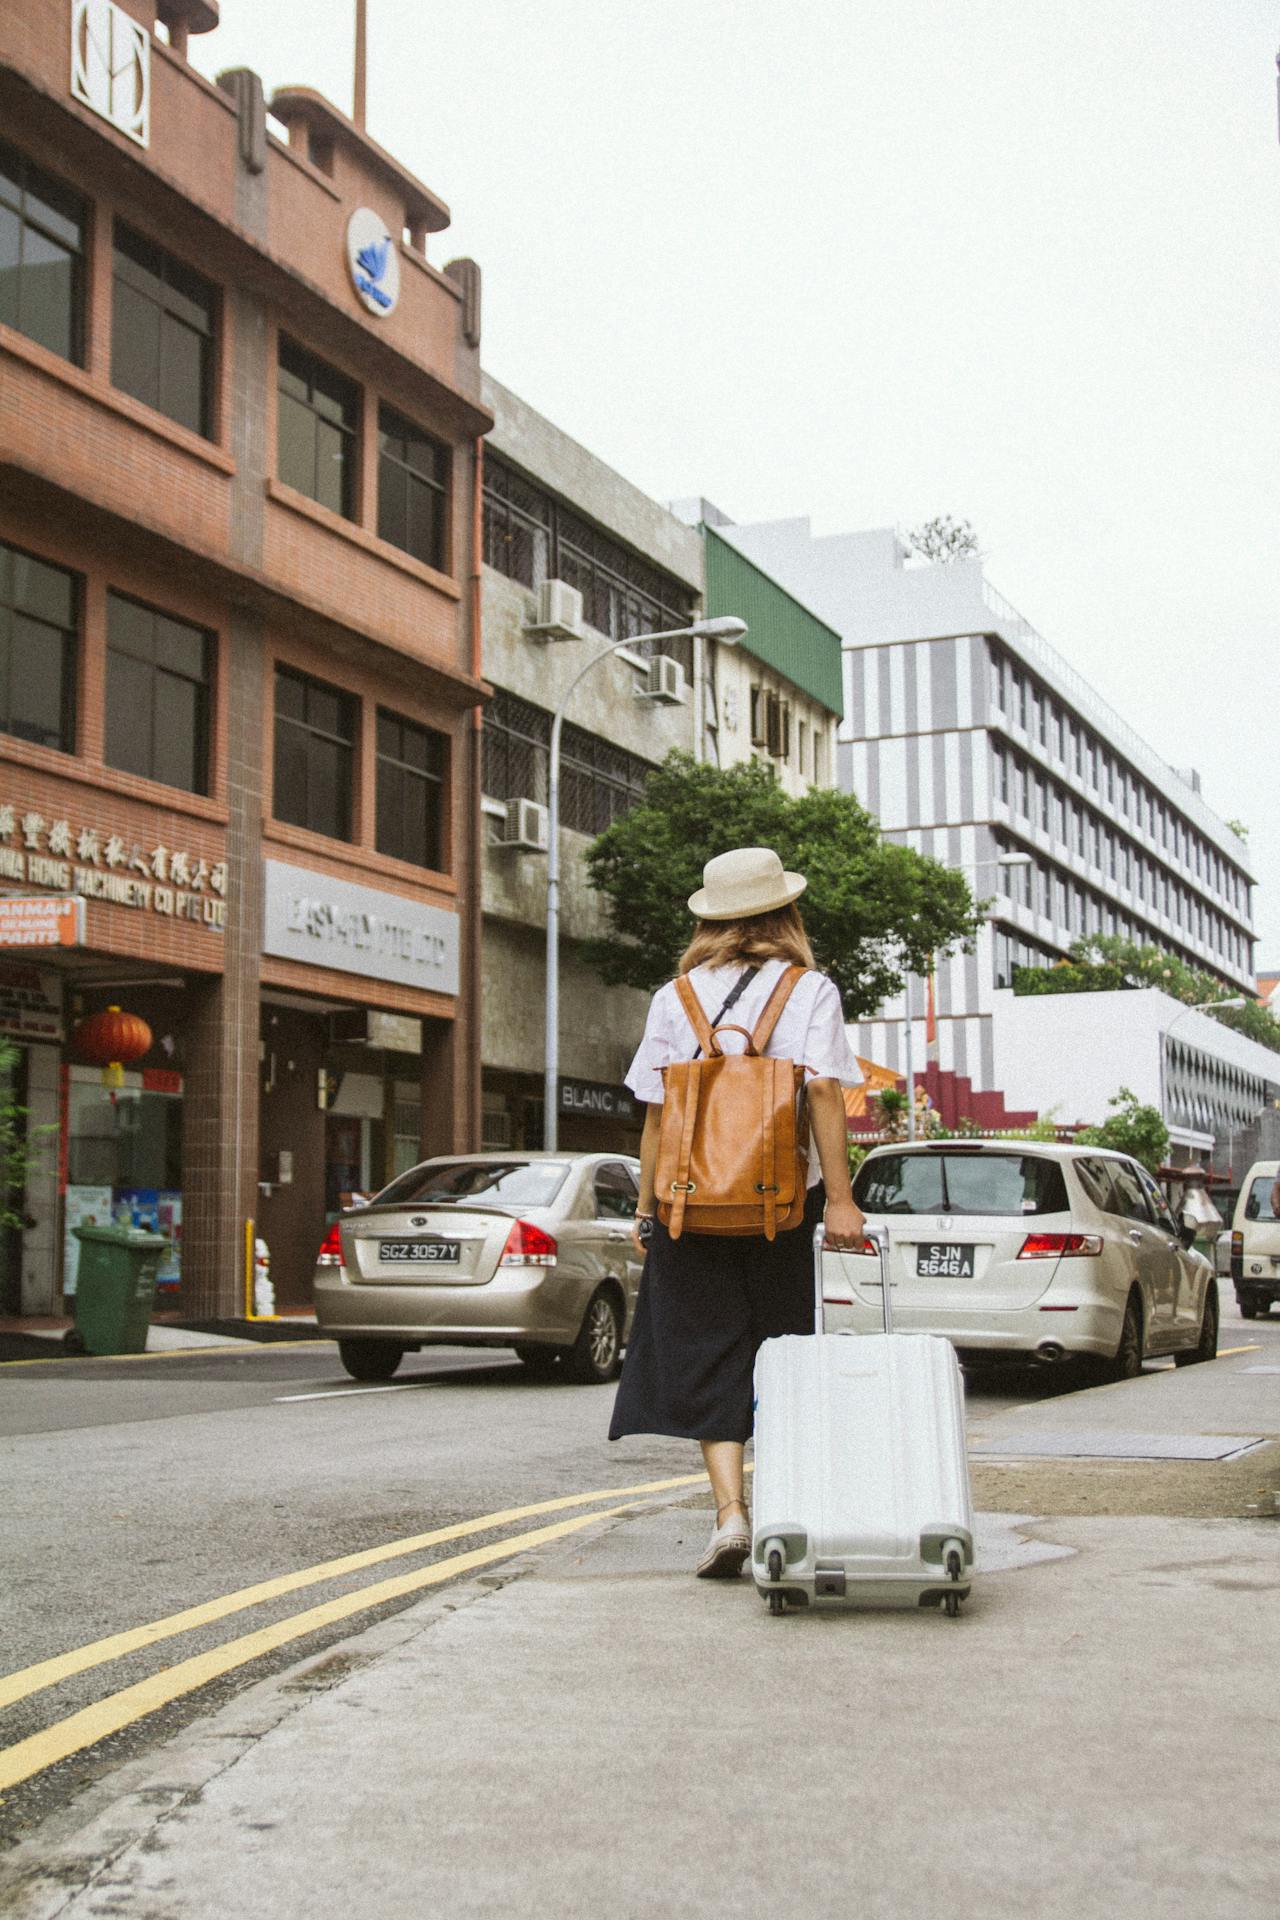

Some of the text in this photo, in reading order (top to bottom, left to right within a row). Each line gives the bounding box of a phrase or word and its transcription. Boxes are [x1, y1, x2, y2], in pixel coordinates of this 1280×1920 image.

[0, 847, 25, 882] WA
[28, 855, 72, 891] HONG
[74, 866, 153, 911] MACHINERY
[154, 885, 175, 915] CO
[175, 890, 201, 922] PTE
[562, 1086, 613, 1112] BLANC
[381, 1244, 457, 1259] SGZ 3057Y
[930, 1246, 961, 1260] SJN
[918, 1260, 971, 1275] 3646A
